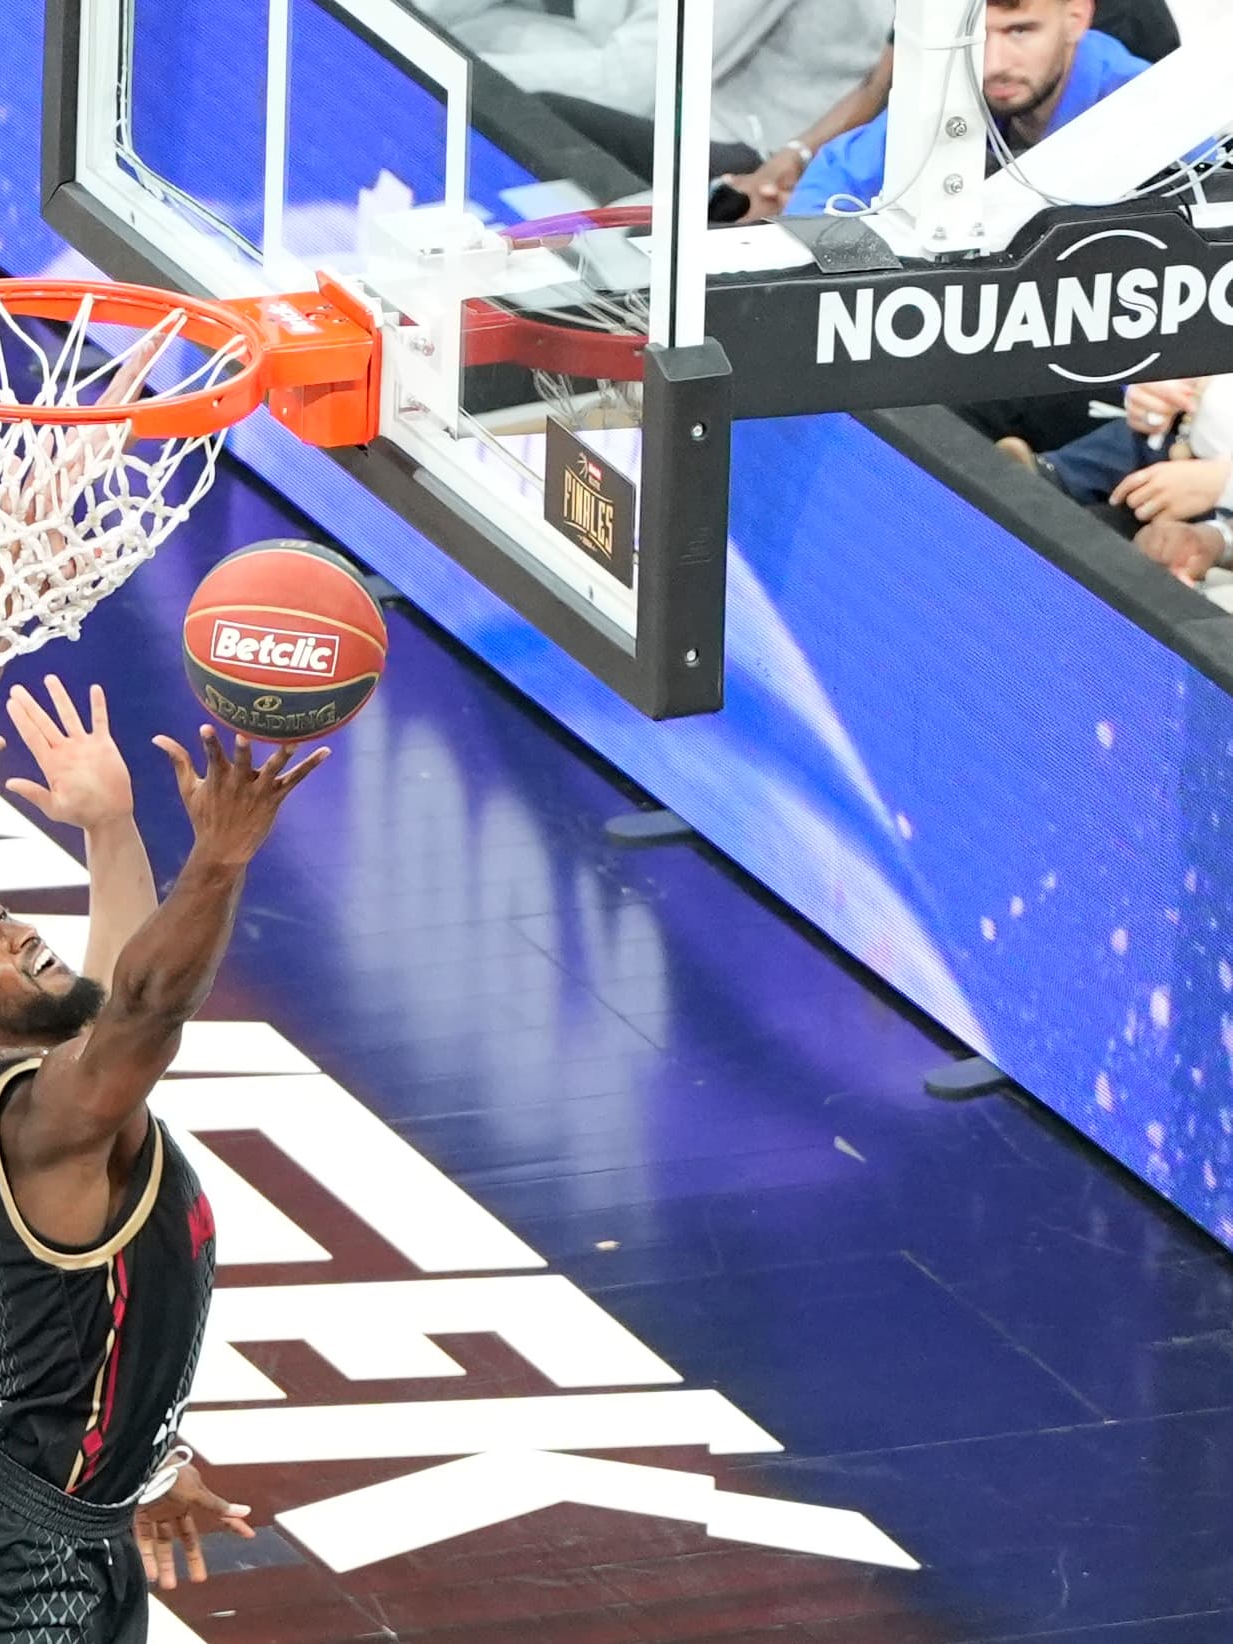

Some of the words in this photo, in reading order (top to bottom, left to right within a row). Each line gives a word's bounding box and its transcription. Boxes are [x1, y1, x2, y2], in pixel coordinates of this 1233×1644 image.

[564, 469, 614, 555] FINALES
[215, 627, 332, 670] Betclic
[205, 684, 336, 729] SPALDING
